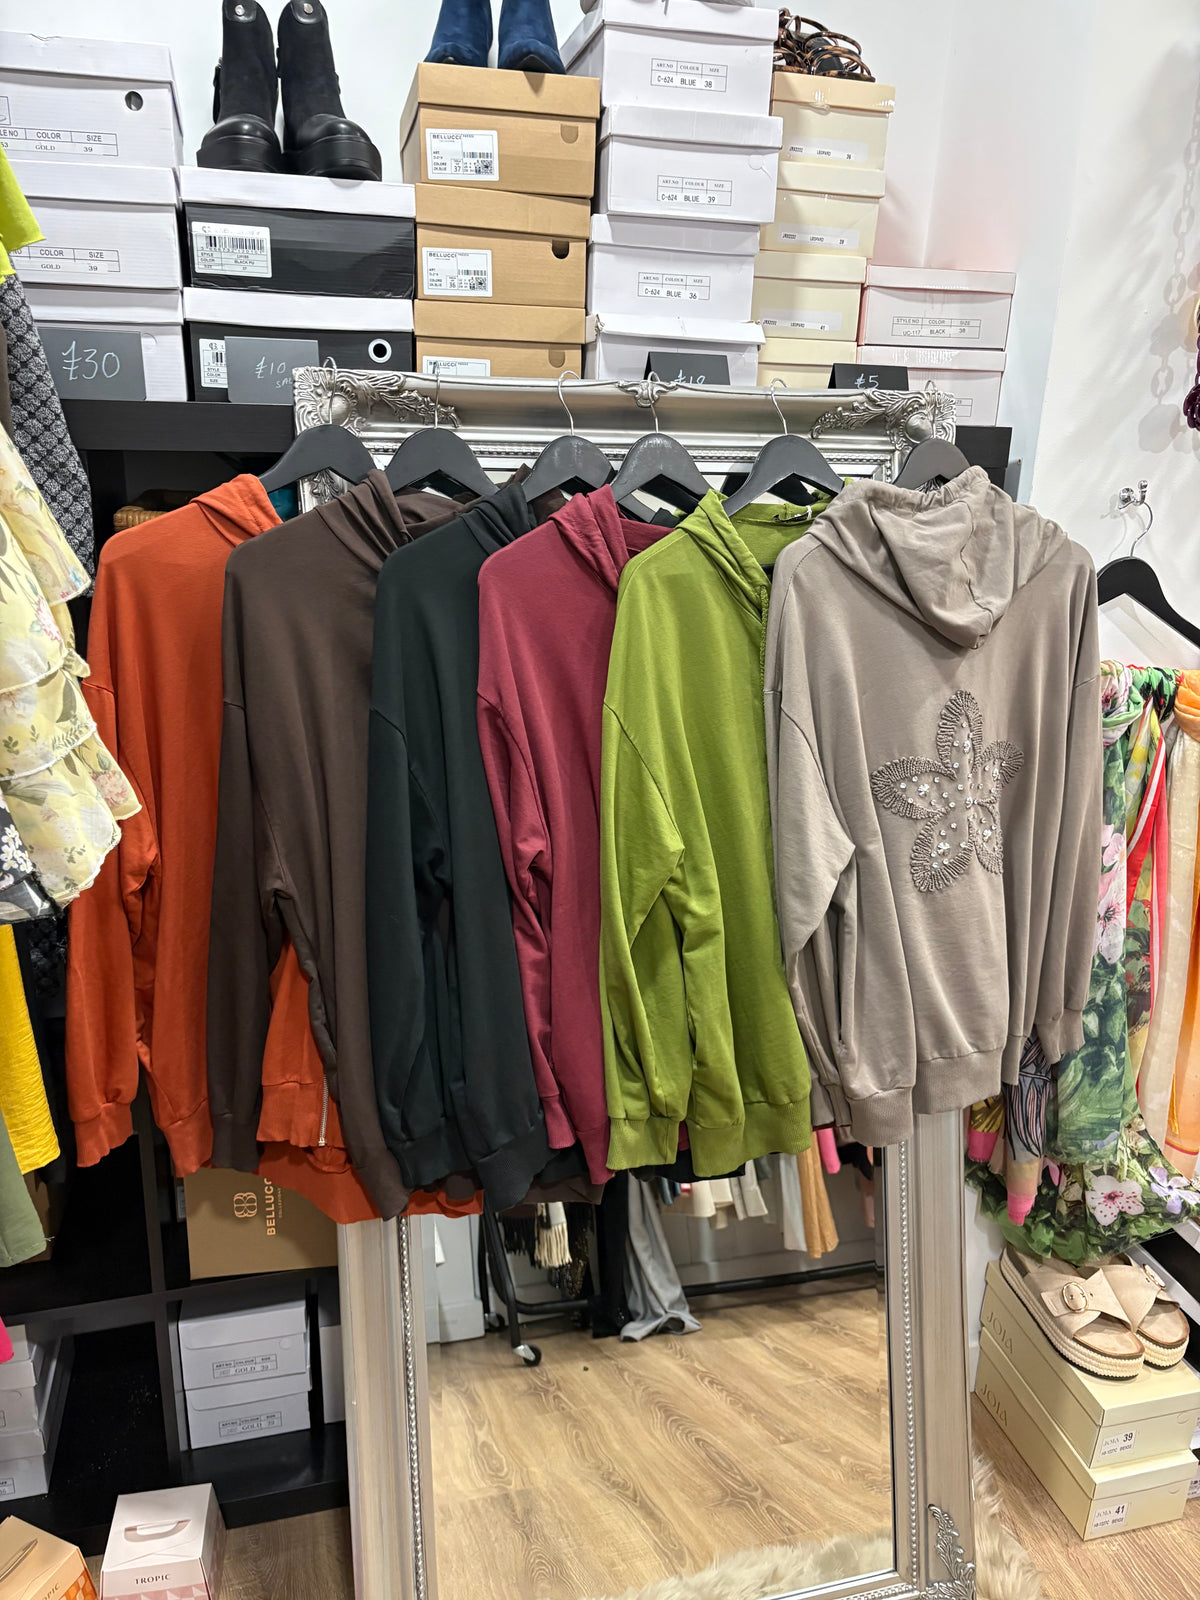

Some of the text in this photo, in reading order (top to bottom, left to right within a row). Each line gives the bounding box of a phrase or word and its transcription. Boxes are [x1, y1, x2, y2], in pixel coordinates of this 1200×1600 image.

[656, 75, 713, 89] C-624 BLUE 38
[0, 129, 8, 137] LE
[36, 131, 62, 140] COLOR
[86, 134, 103, 143] SIZE
[432, 133, 462, 141] BELLUCCI
[453, 165, 462, 173] 37
[661, 193, 716, 204] C-624 BLUE 39
[39, 248, 65, 257] COLOR
[88, 251, 105, 259] SIZE
[644, 287, 698, 300] C-624 BLUE 36
[902, 329, 921, 337] UC-117
[929, 328, 946, 336] BLACK
[61, 340, 121, 381] £30
[428, 360, 457, 368] BLUCCI
[254, 355, 287, 379] £10
[275, 376, 293, 389] SAL
[853, 372, 880, 390] £5
[986, 1311, 1013, 1355] JOIA
[234, 1365, 256, 1374] GOLD
[980, 1383, 1008, 1427] JOIA
[1122, 1432, 1134, 1443] 39
[1115, 1504, 1125, 1515] 41
[135, 1573, 171, 1585] TROPIC
